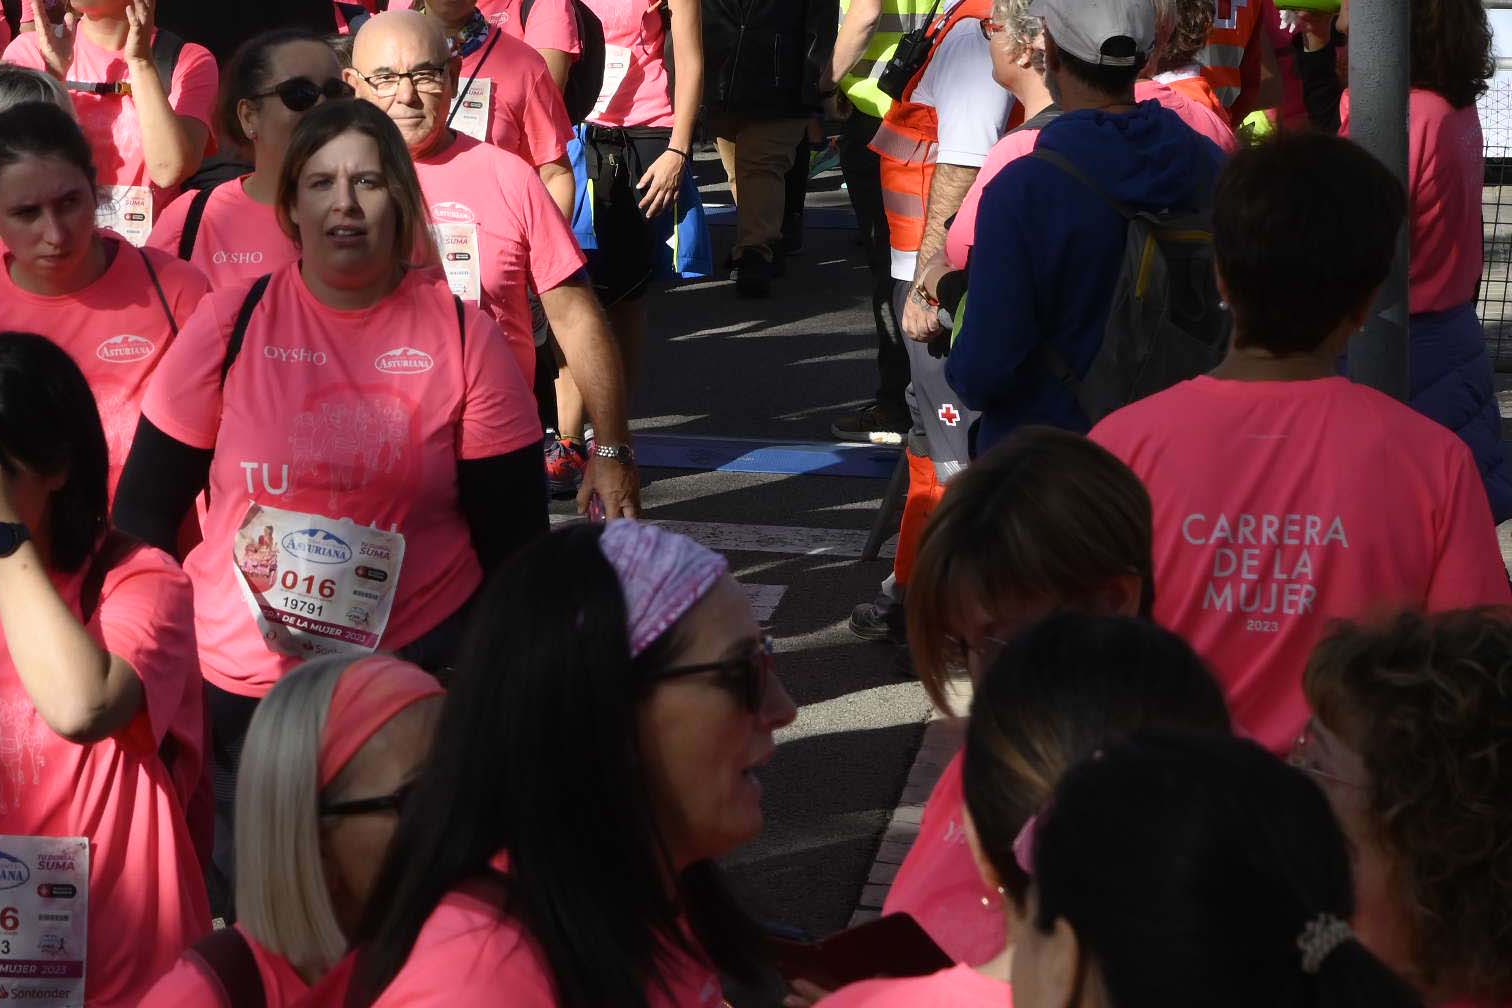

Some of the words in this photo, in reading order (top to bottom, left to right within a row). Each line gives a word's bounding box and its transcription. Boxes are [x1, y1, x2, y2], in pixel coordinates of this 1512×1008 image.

[213, 250, 263, 264] OYSHO
[102, 346, 151, 357] ASTURIANA
[264, 345, 327, 366] OYSHO
[380, 358, 429, 369] ASTURIANA
[240, 461, 289, 495] TU
[1182, 513, 1350, 549] CARRERA
[359, 547, 391, 561] SUMA
[1213, 548, 1260, 580] DE
[1274, 548, 1312, 580] LA
[281, 570, 337, 598] 016
[283, 596, 324, 617] 19791
[1202, 581, 1317, 615] MUJER
[281, 614, 295, 624] DE
[296, 617, 308, 629] LA
[310, 623, 343, 636] MUJER
[1246, 620, 1280, 632] 2023
[38, 861, 76, 872] SUMA
[0, 964, 37, 974] MUJER
[10, 987, 71, 1000] Santander
